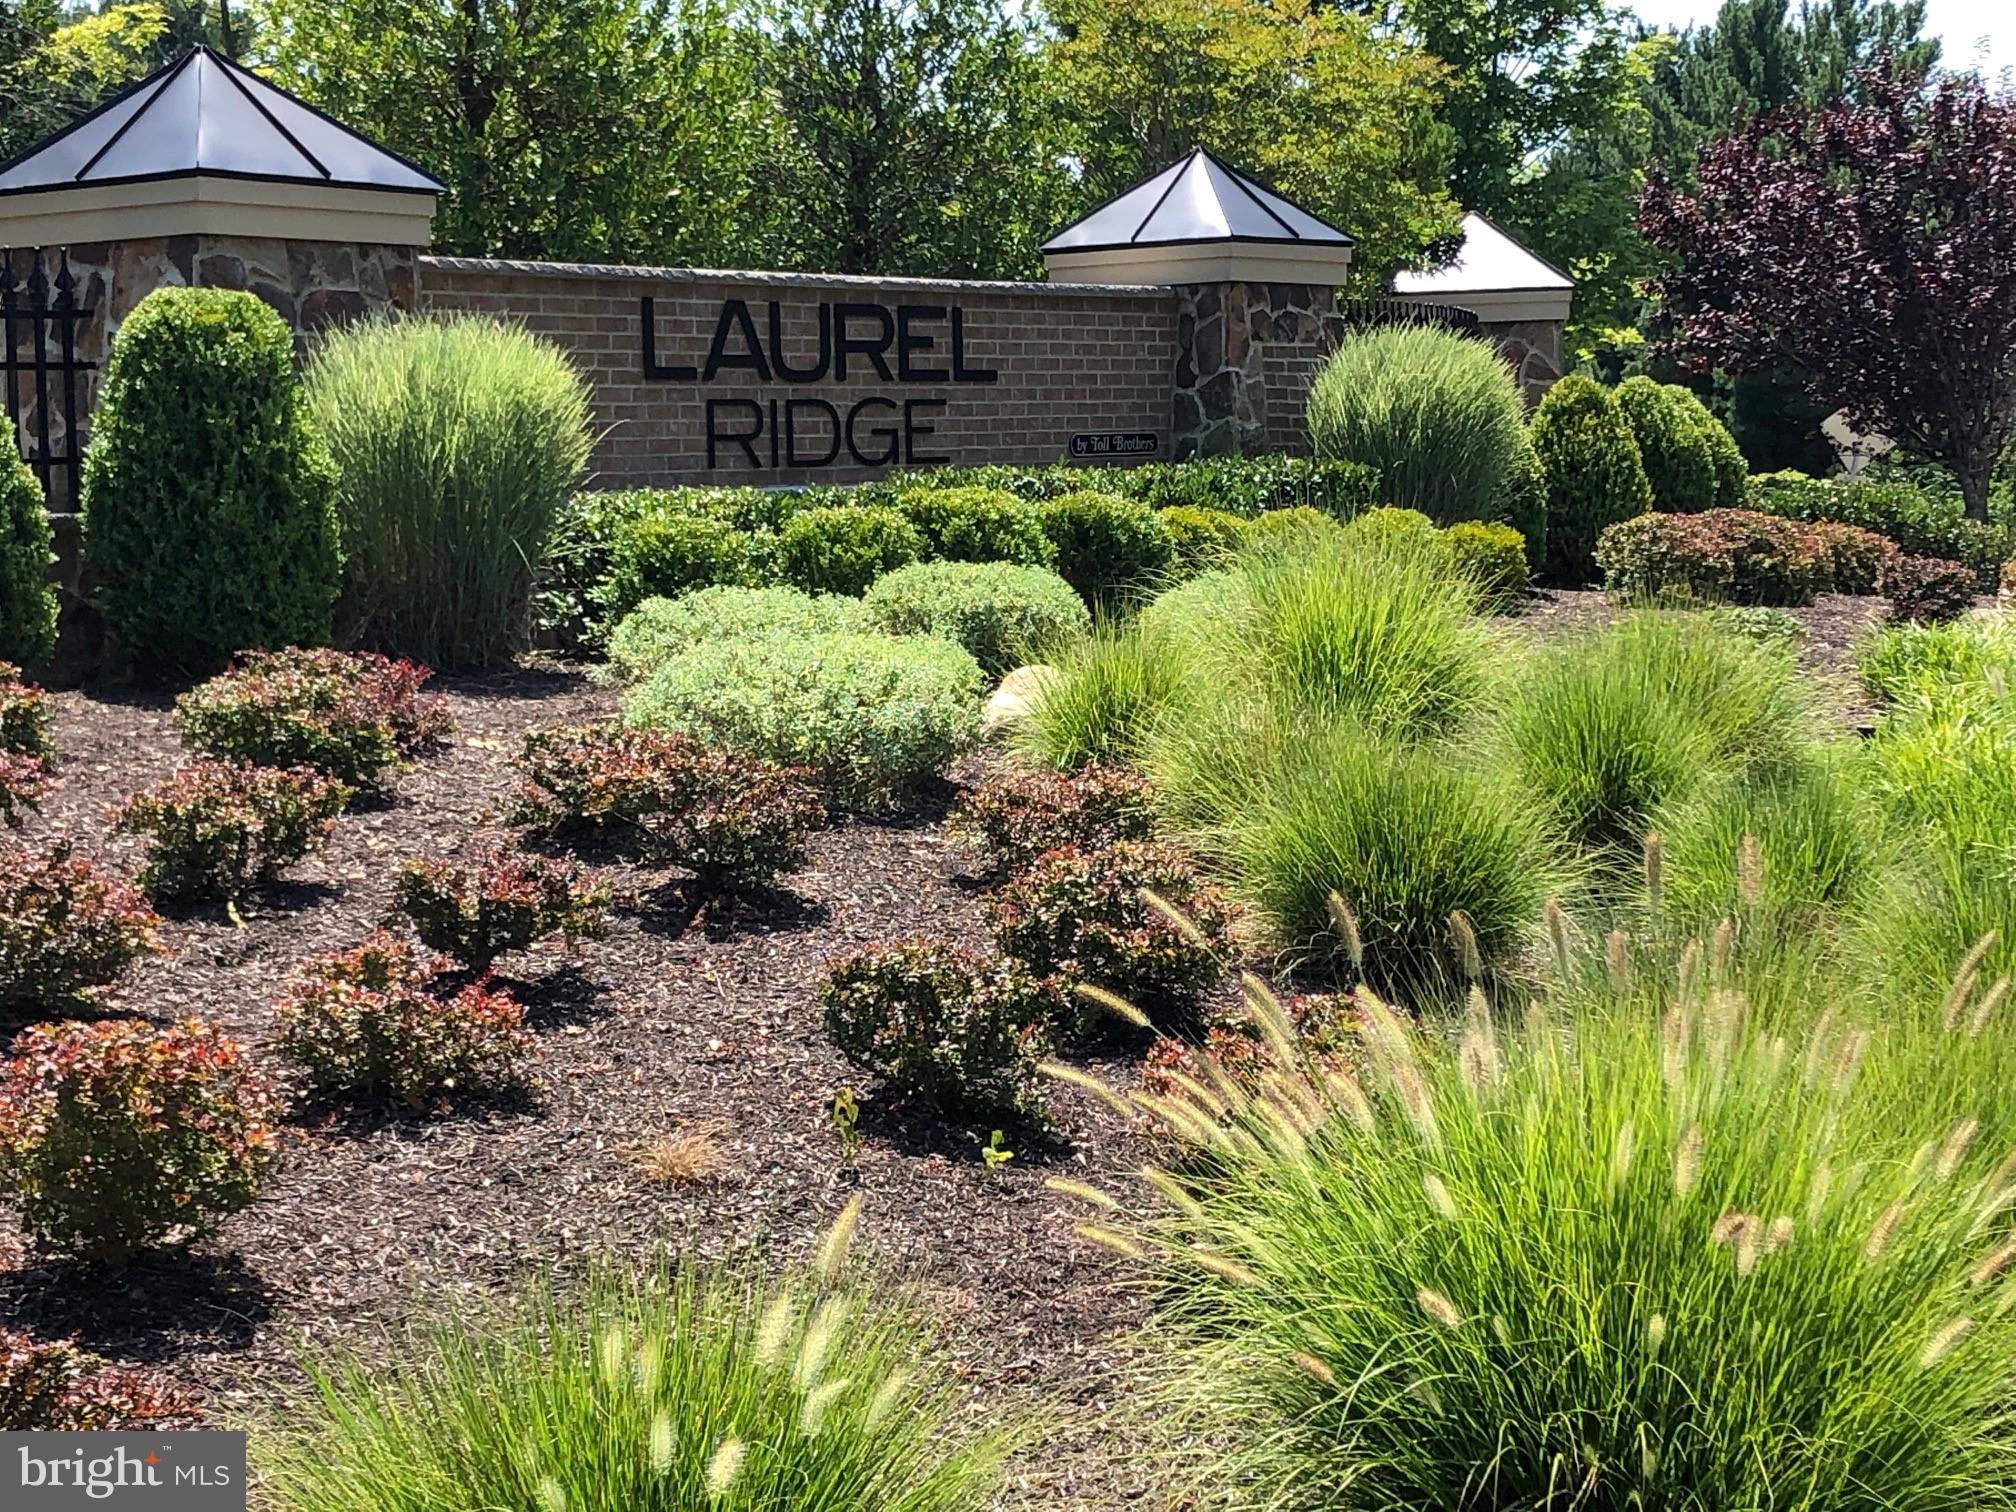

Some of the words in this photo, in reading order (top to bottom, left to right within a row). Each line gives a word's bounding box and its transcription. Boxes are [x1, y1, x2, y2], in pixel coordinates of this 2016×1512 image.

[641, 296, 998, 383] LAUREL
[706, 396, 950, 469] RIDGE
[1077, 438, 1088, 454] by
[1090, 436, 1110, 451] Toll
[1112, 435, 1154, 452] Brothers
